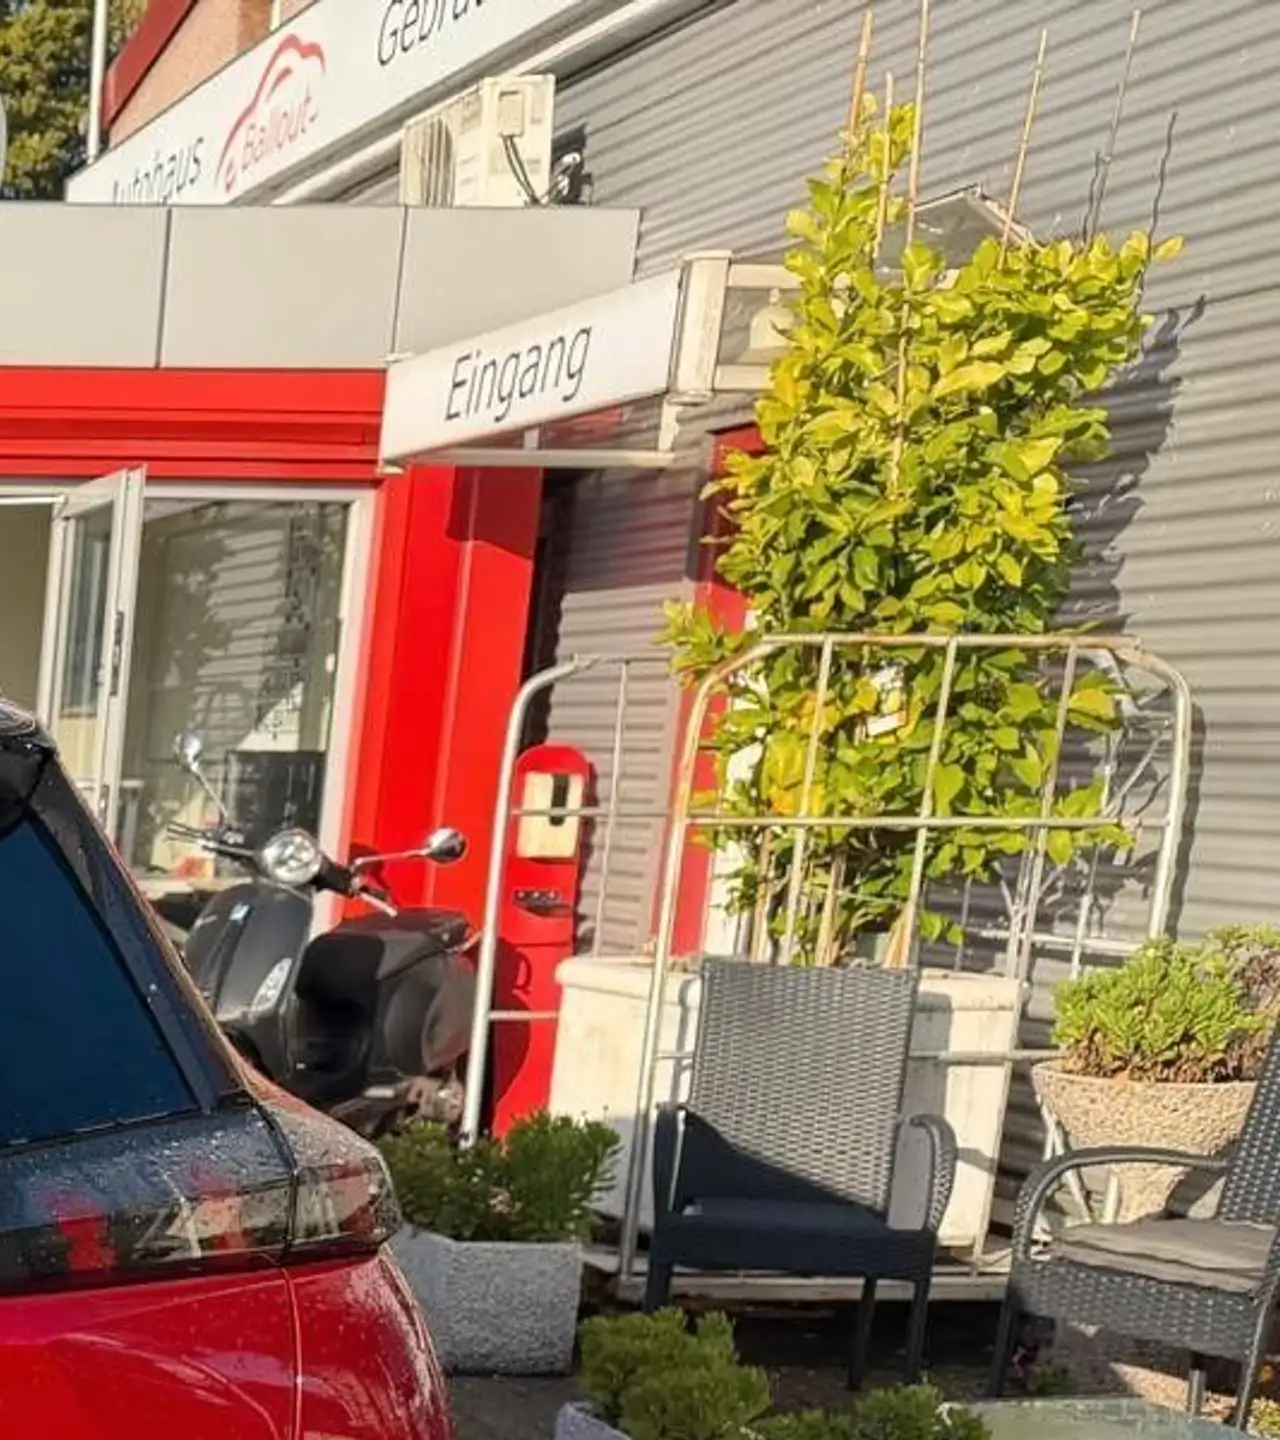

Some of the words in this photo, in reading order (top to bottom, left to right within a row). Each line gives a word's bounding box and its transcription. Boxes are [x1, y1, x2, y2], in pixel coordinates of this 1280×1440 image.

[378, 0, 483, 66] Gebr
[113, 137, 205, 204] tohaus
[445, 326, 592, 423] Eingang
